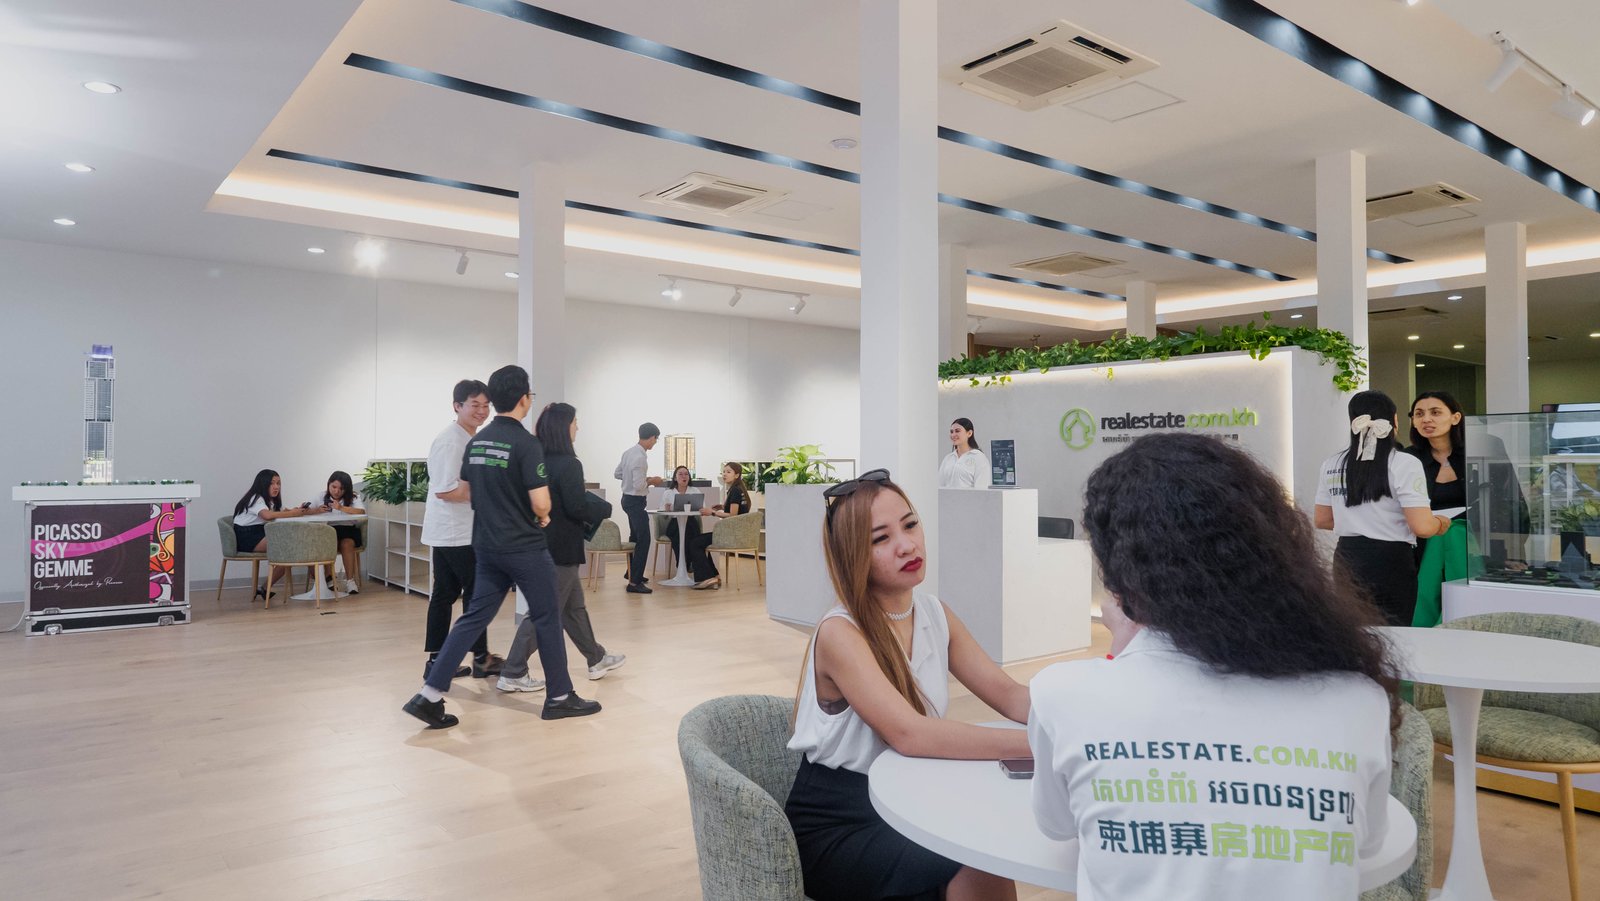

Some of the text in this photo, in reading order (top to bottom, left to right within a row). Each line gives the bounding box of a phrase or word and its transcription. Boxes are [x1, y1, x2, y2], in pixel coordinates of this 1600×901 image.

[1101, 407, 1258, 430] realestate.com.kh
[34, 522, 102, 541] PICASSO
[34, 542, 68, 560] SKY
[33, 559, 94, 579] GEMME
[1084, 741, 1357, 772] REALESTATE.COM.KH
[1098, 819, 1354, 866] 柬埔寨房地产网
